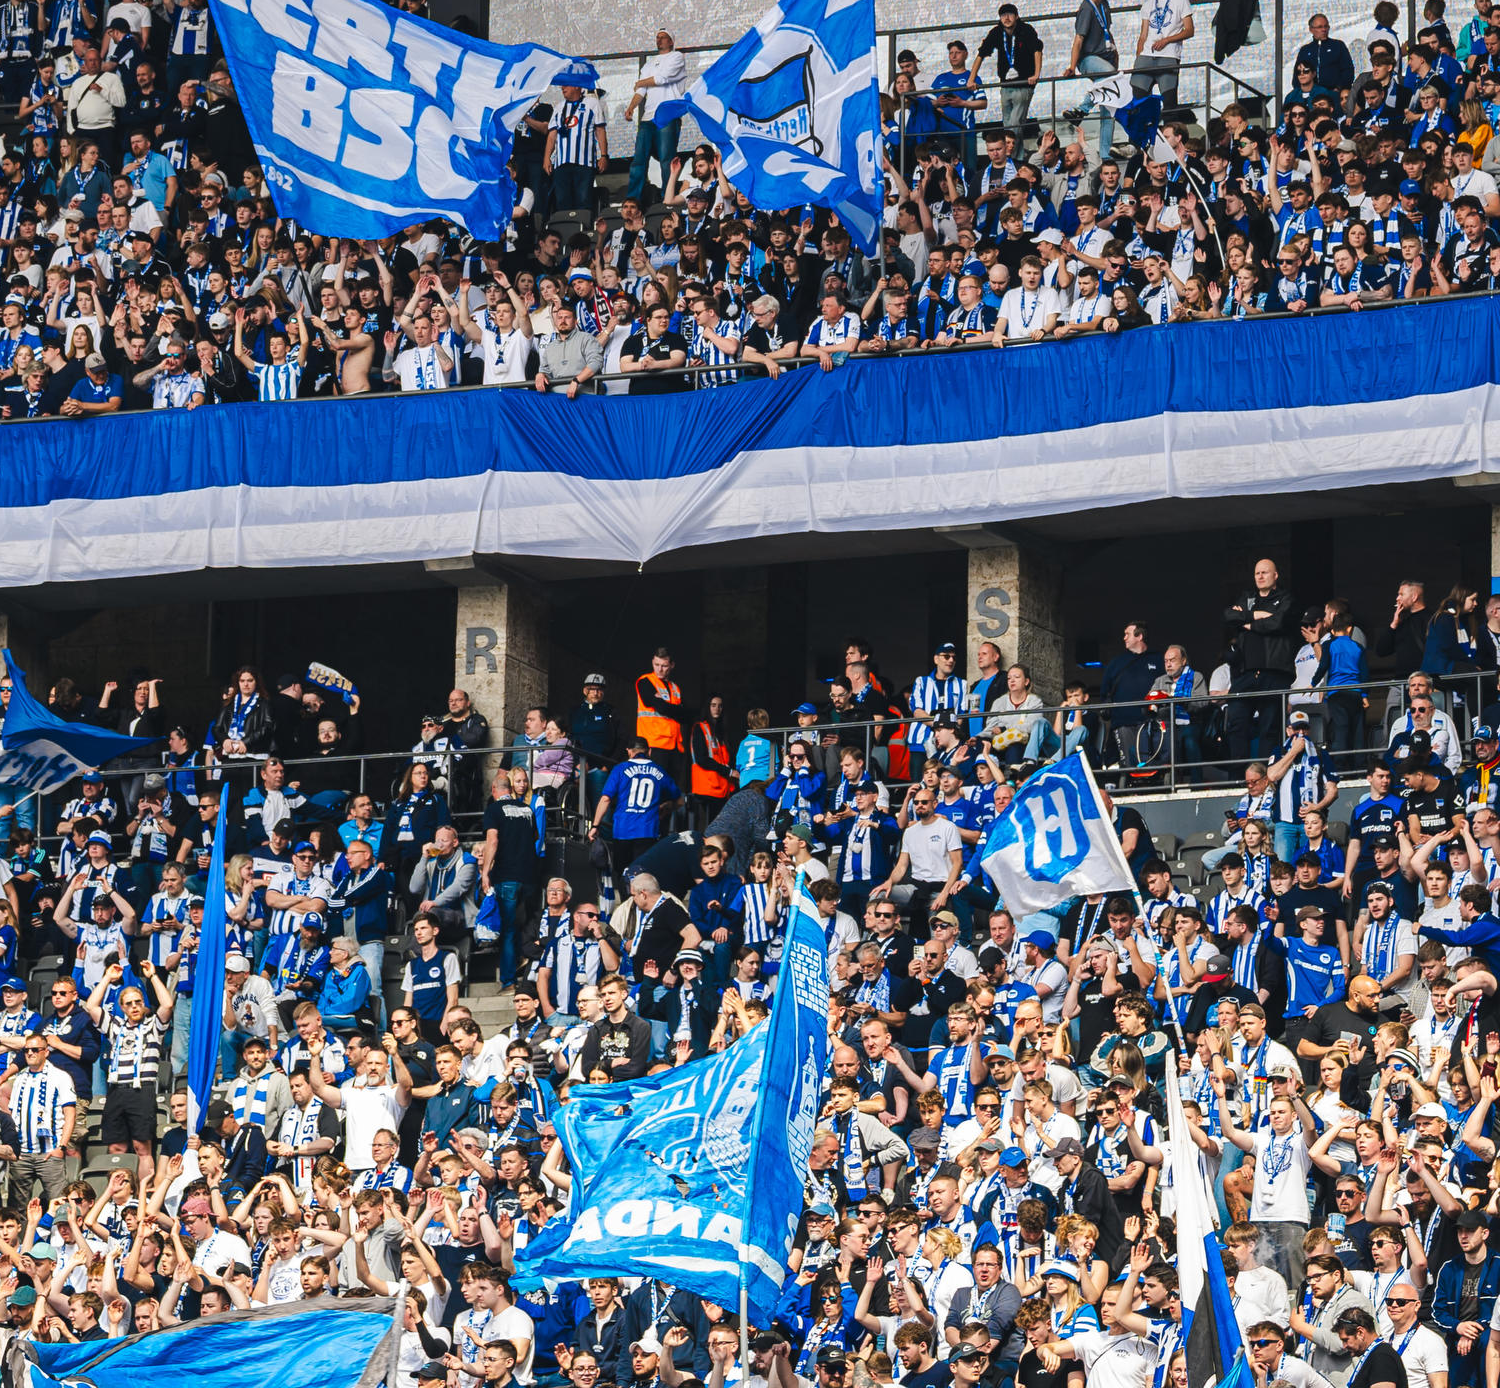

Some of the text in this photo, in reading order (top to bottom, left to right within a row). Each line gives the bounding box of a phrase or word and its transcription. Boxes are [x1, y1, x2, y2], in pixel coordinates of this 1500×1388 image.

[271, 52, 480, 200] BSC
[976, 587, 1011, 639] S
[465, 628, 498, 675] R
[627, 777, 654, 809] 10
